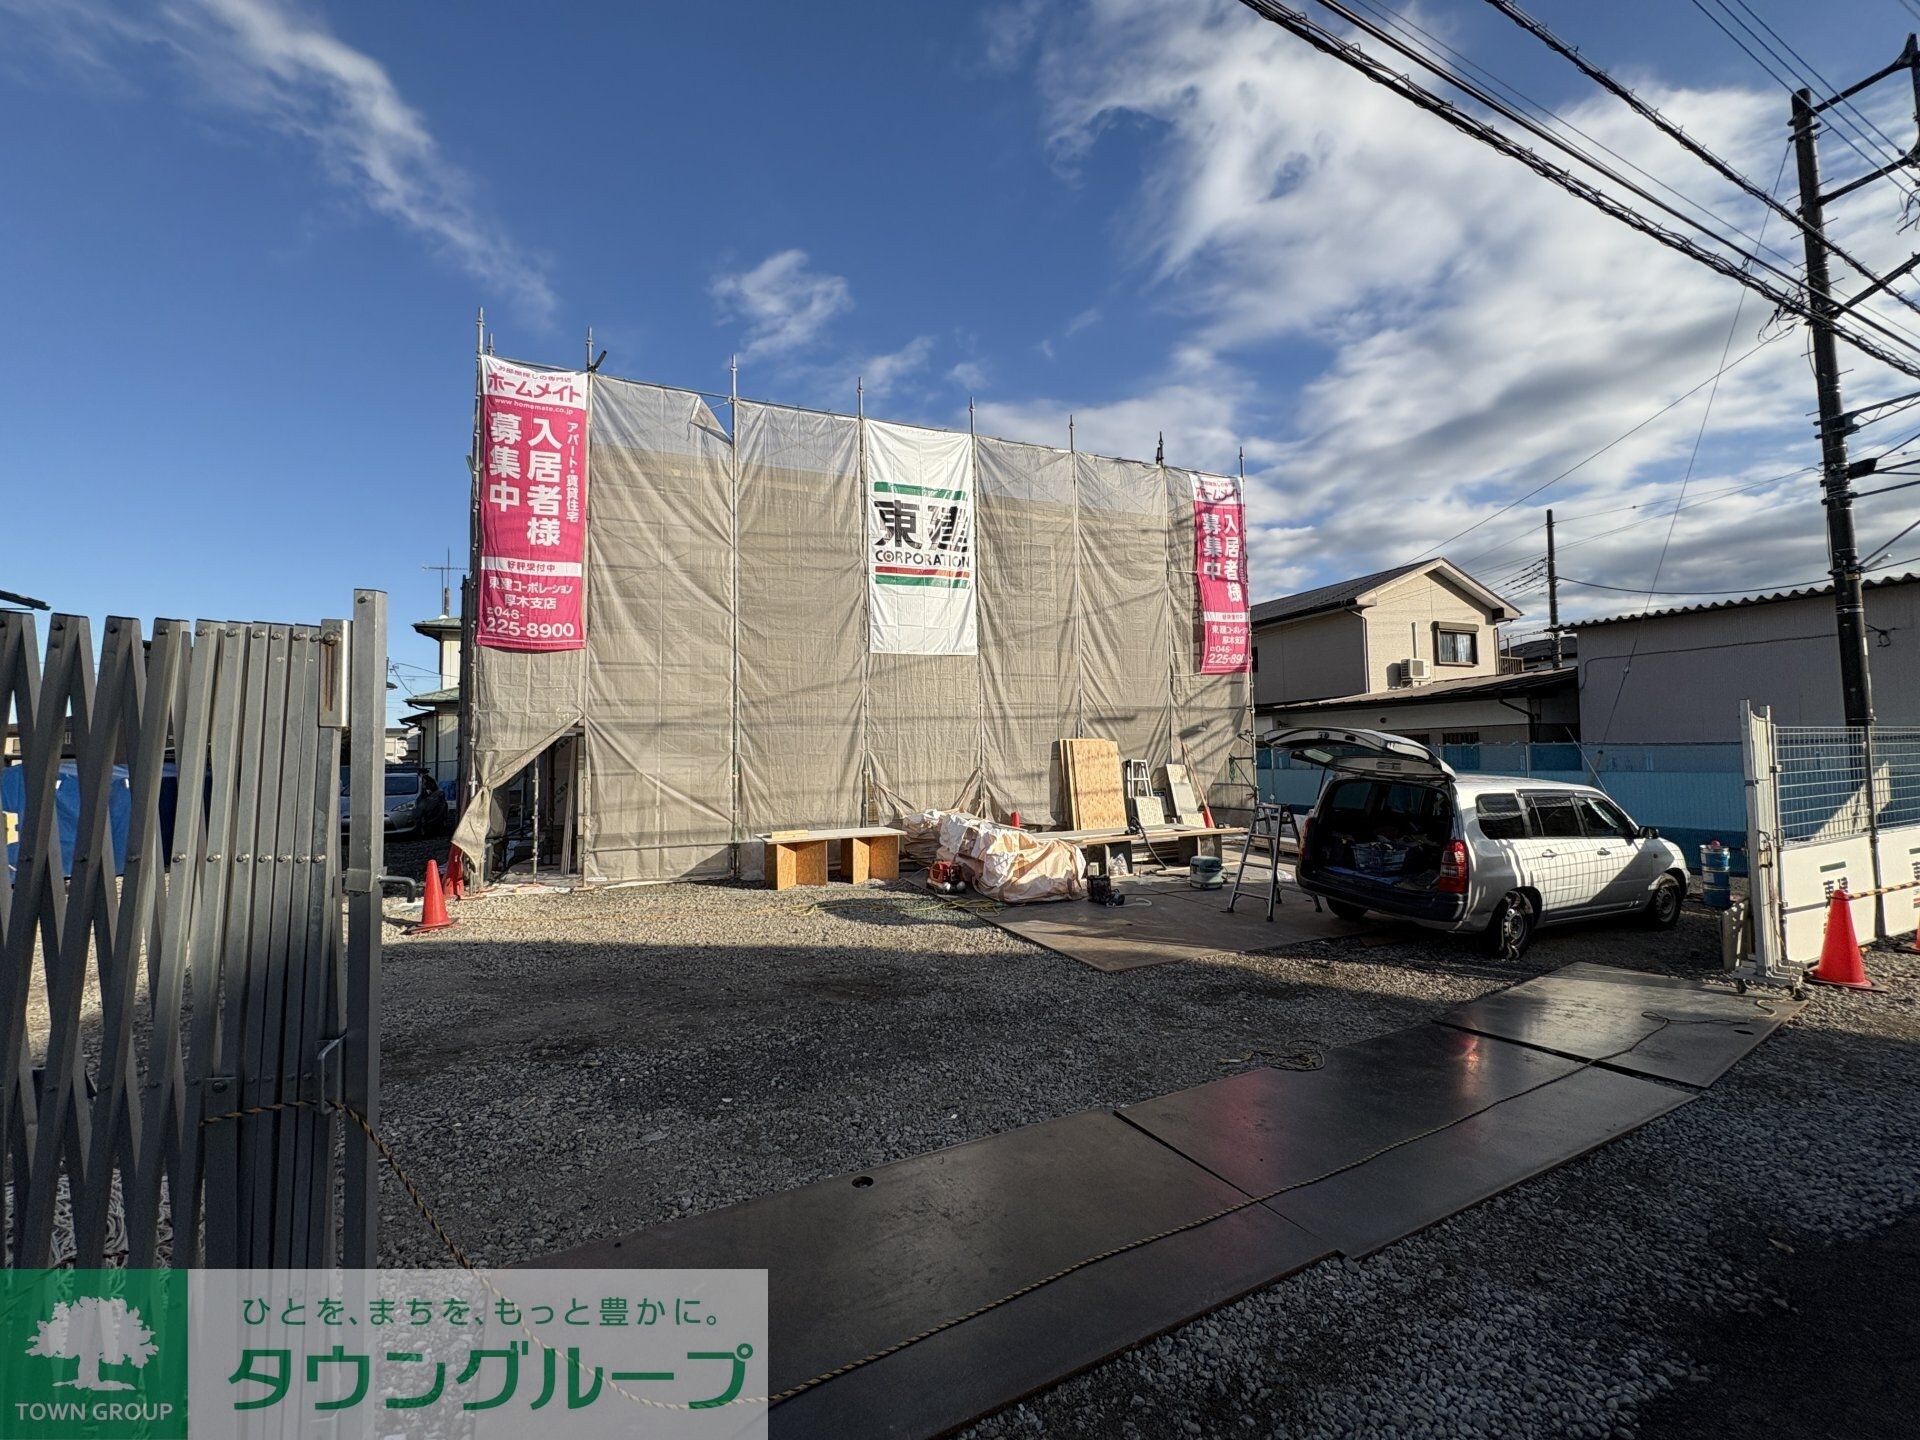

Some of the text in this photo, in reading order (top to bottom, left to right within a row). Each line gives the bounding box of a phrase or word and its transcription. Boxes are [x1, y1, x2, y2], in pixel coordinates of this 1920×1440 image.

[488, 373, 582, 403] ホームメイト
[489, 411, 522, 512] 募集中
[527, 417, 562, 546] 入居者様
[875, 549, 970, 568] CORPORATION
[1202, 512, 1222, 580] 募集中
[1224, 513, 1243, 603] 入居者様
[504, 594, 557, 610] 厚木支店
[486, 617, 575, 638] 225-8900
